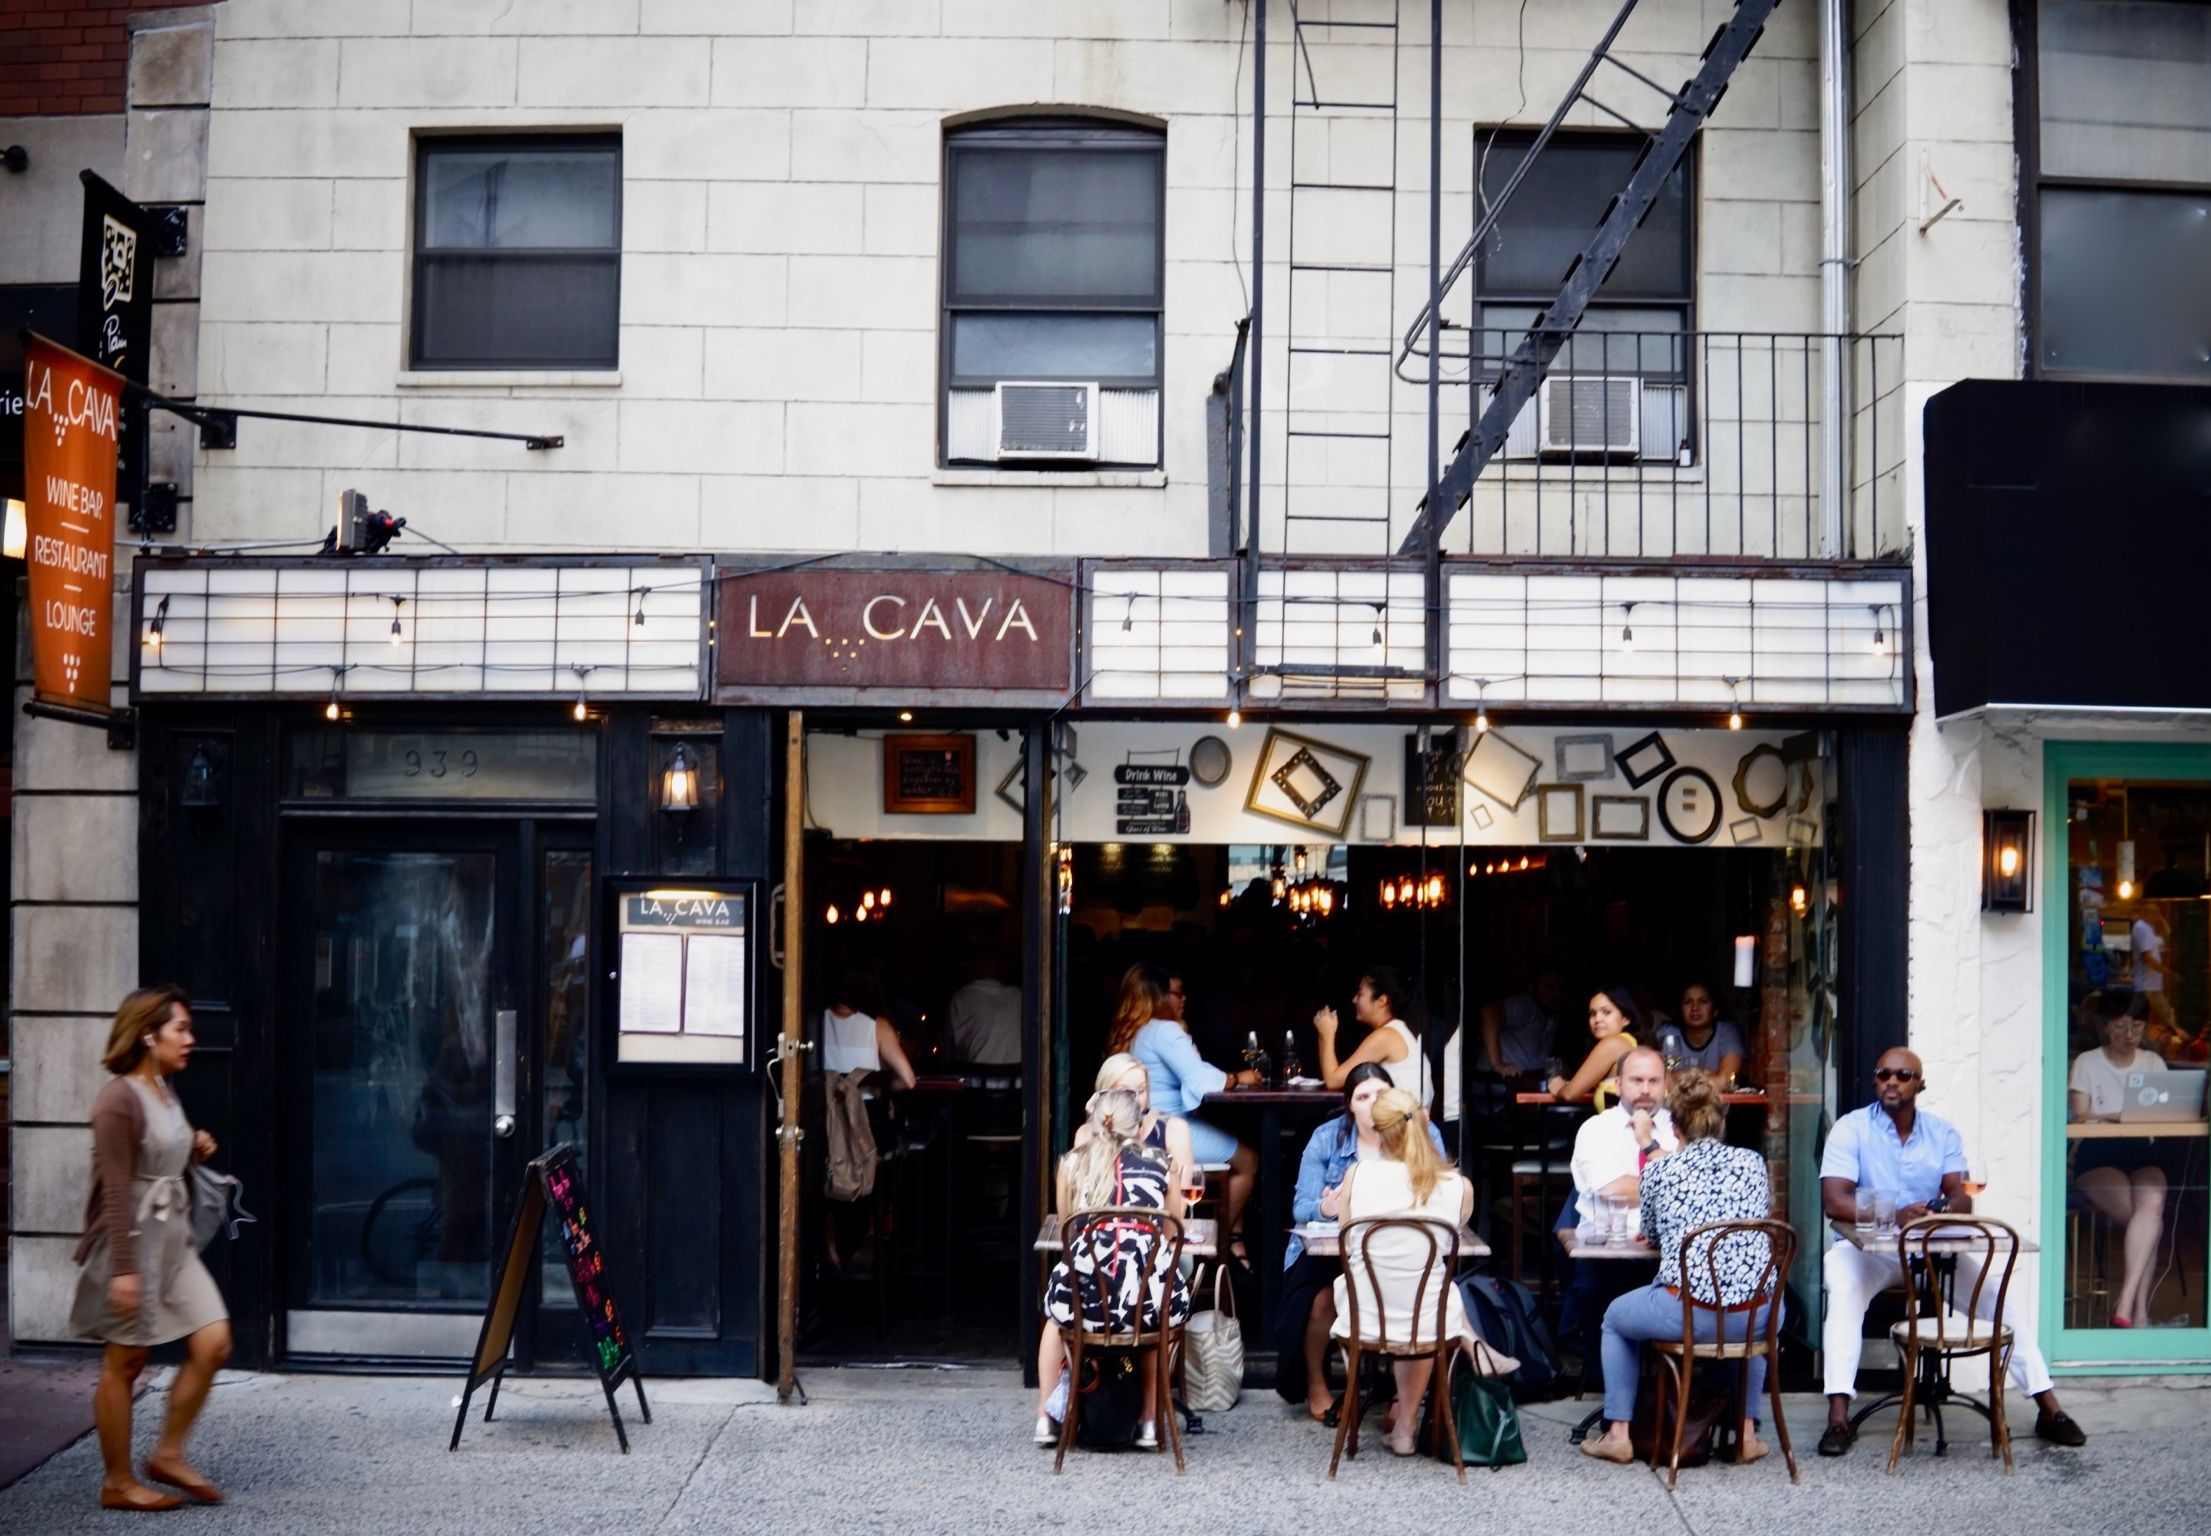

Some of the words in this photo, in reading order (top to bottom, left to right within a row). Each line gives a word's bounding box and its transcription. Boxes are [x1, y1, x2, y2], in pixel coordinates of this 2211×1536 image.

[26, 359, 52, 416] LA
[67, 378, 117, 442] CAVA
[46, 475, 79, 513] WINE
[80, 485, 104, 521] BAR
[34, 535, 109, 580] RESTAURANT
[46, 599, 97, 638] LOUNGE
[749, 594, 819, 639] LA
[862, 594, 1039, 642] CAVA
[404, 749, 478, 777] 939
[1125, 769, 1151, 781] Drink
[1153, 769, 1178, 782] Wine
[640, 898, 663, 915] LA
[675, 898, 730, 917] CAVA
